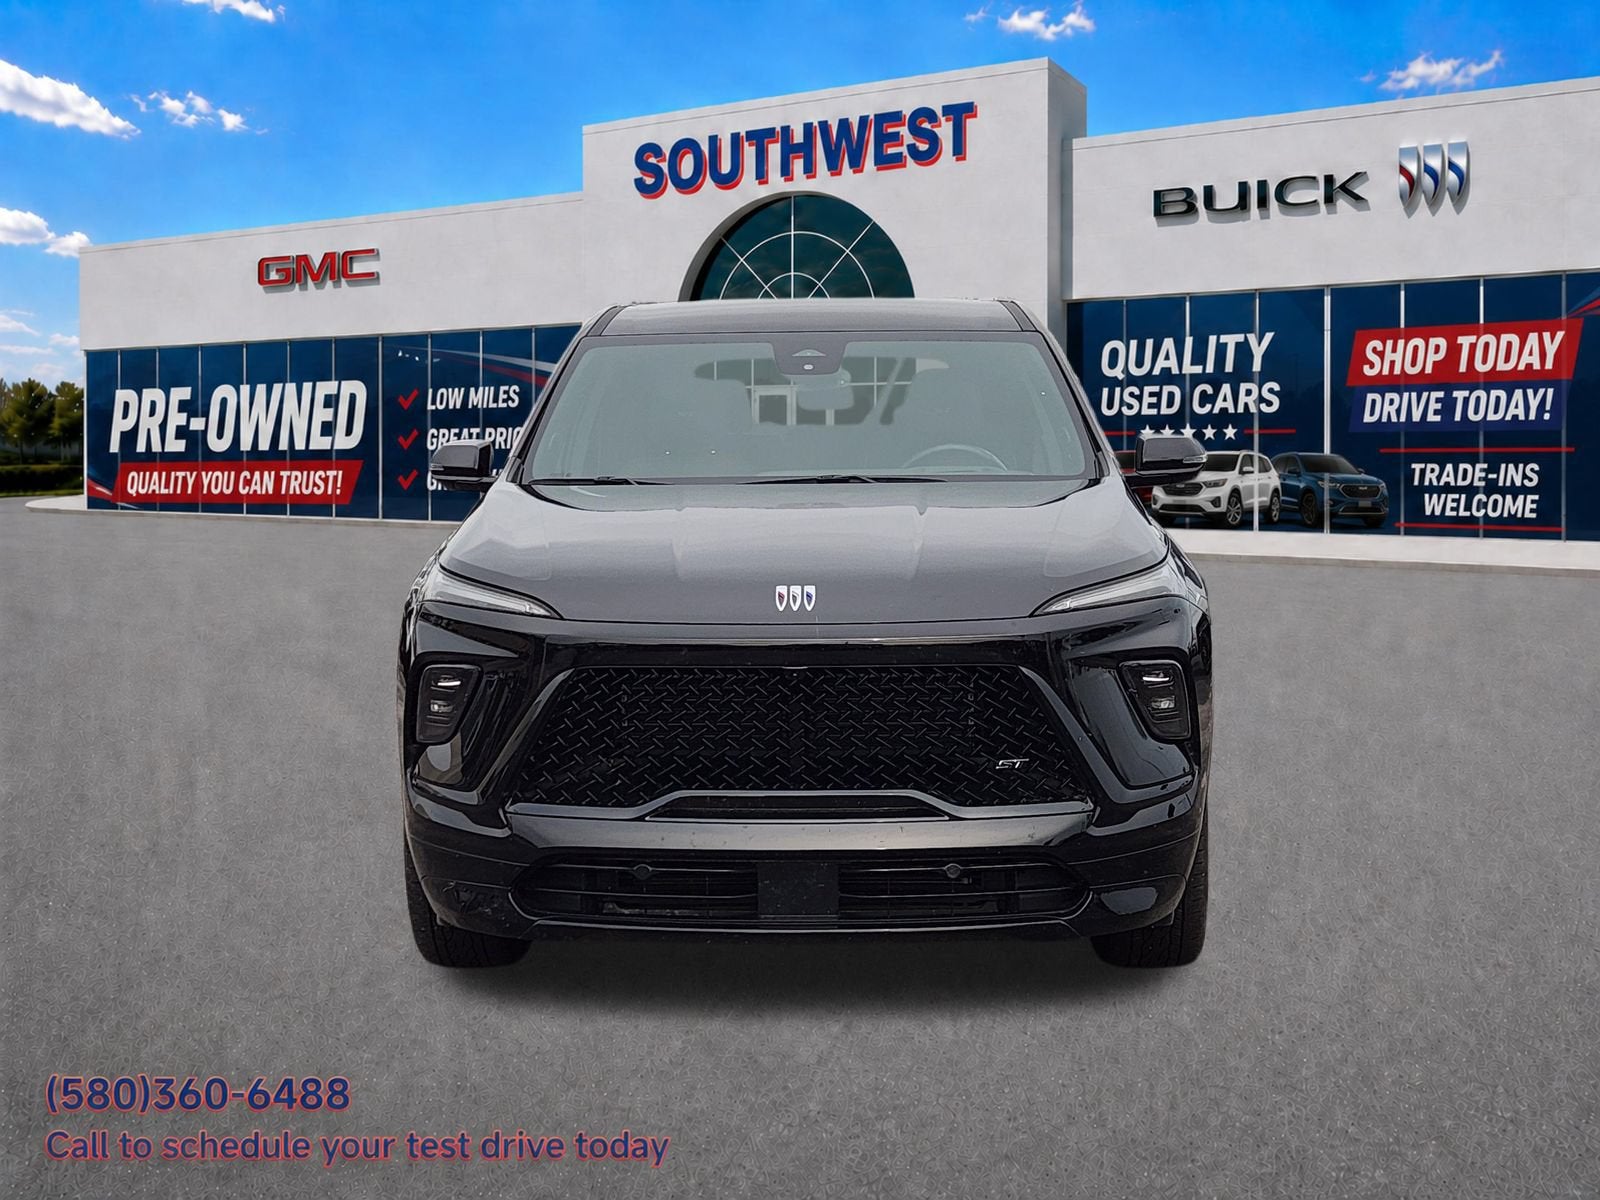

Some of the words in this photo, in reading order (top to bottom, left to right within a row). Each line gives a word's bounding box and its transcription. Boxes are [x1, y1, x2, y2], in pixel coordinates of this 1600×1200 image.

[633, 101, 978, 199] SOUTHWEST
[1153, 171, 1368, 218] BUICK
[257, 247, 379, 287] GMC
[1101, 332, 1275, 379] QUALITY
[1363, 336, 1447, 377] SHOP
[1456, 330, 1566, 373] TODAY
[109, 380, 367, 452] PRE-OWNED
[427, 387, 464, 411] LOW
[468, 385, 520, 409] MILES
[1101, 385, 1181, 417] USED
[1192, 381, 1281, 415] CARS
[1363, 391, 1444, 423] DRIVE
[1452, 388, 1555, 421] TODAY!
[426, 427, 480, 451] GREAT
[126, 471, 197, 496] QUALITY
[199, 471, 235, 496] YOU
[238, 471, 276, 495] CAN
[279, 469, 343, 496] TRUST!
[1411, 462, 1540, 488] TRADE-INS
[1424, 493, 1539, 519] WELCOME
